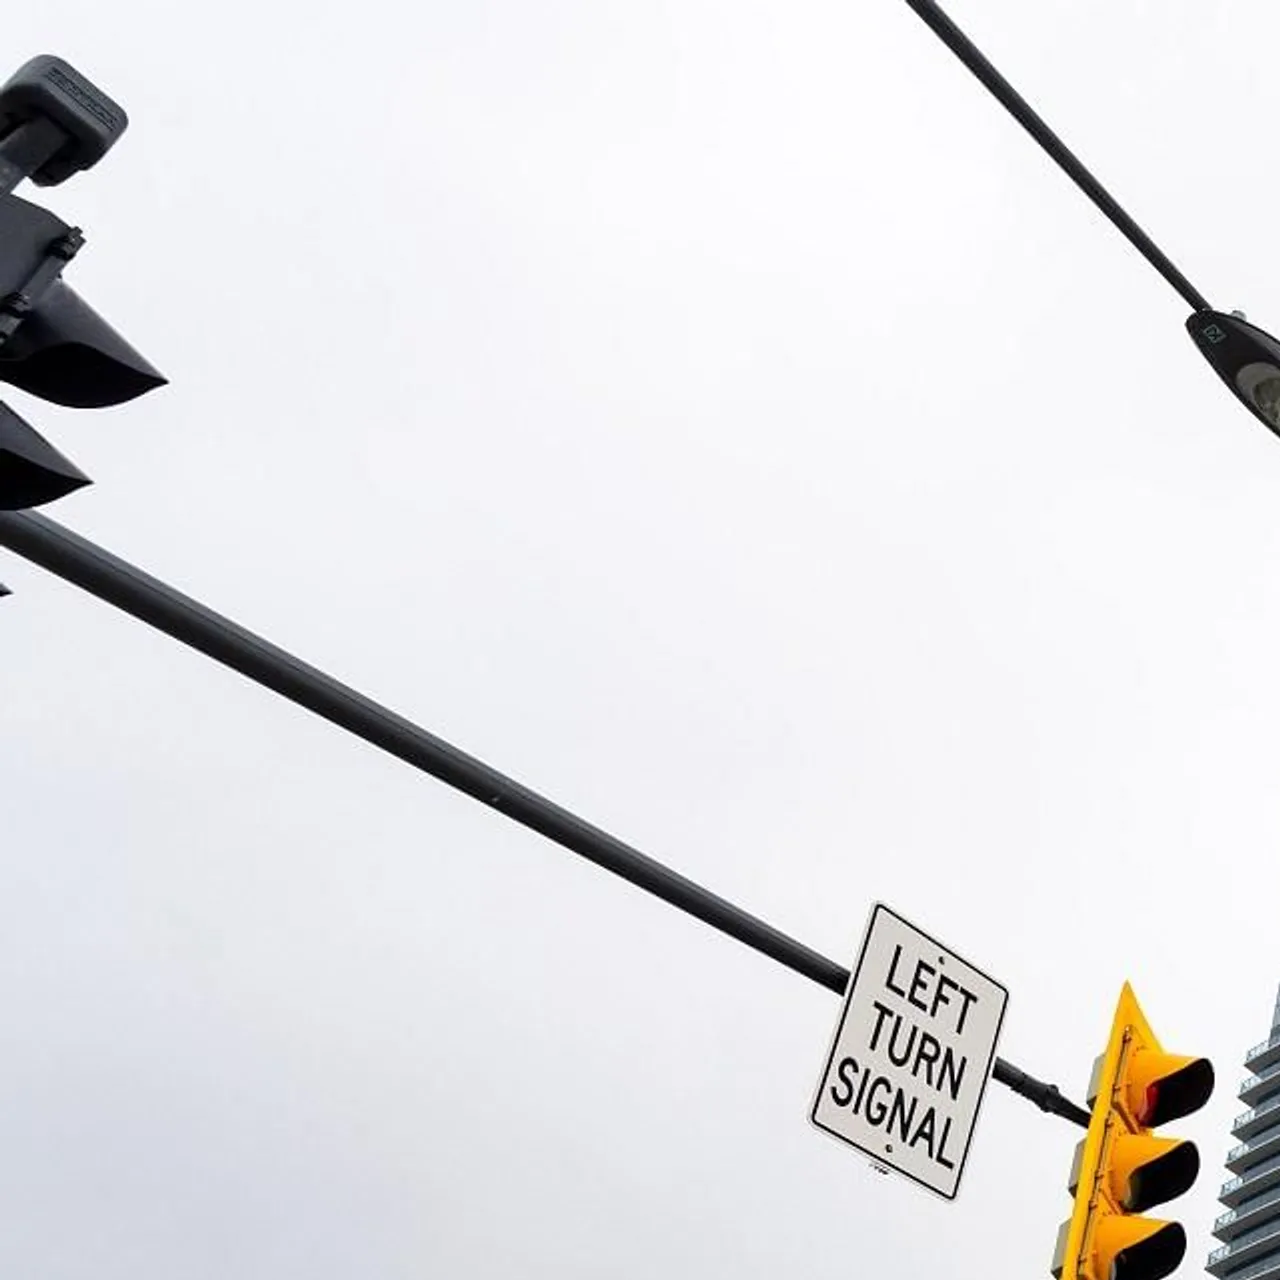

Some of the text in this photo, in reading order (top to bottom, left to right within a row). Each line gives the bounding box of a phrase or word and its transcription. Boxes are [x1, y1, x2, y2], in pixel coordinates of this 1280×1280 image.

[885, 944, 978, 1035] LEFT
[869, 1000, 967, 1101] TURN
[830, 1056, 955, 1170] SIGNAL
